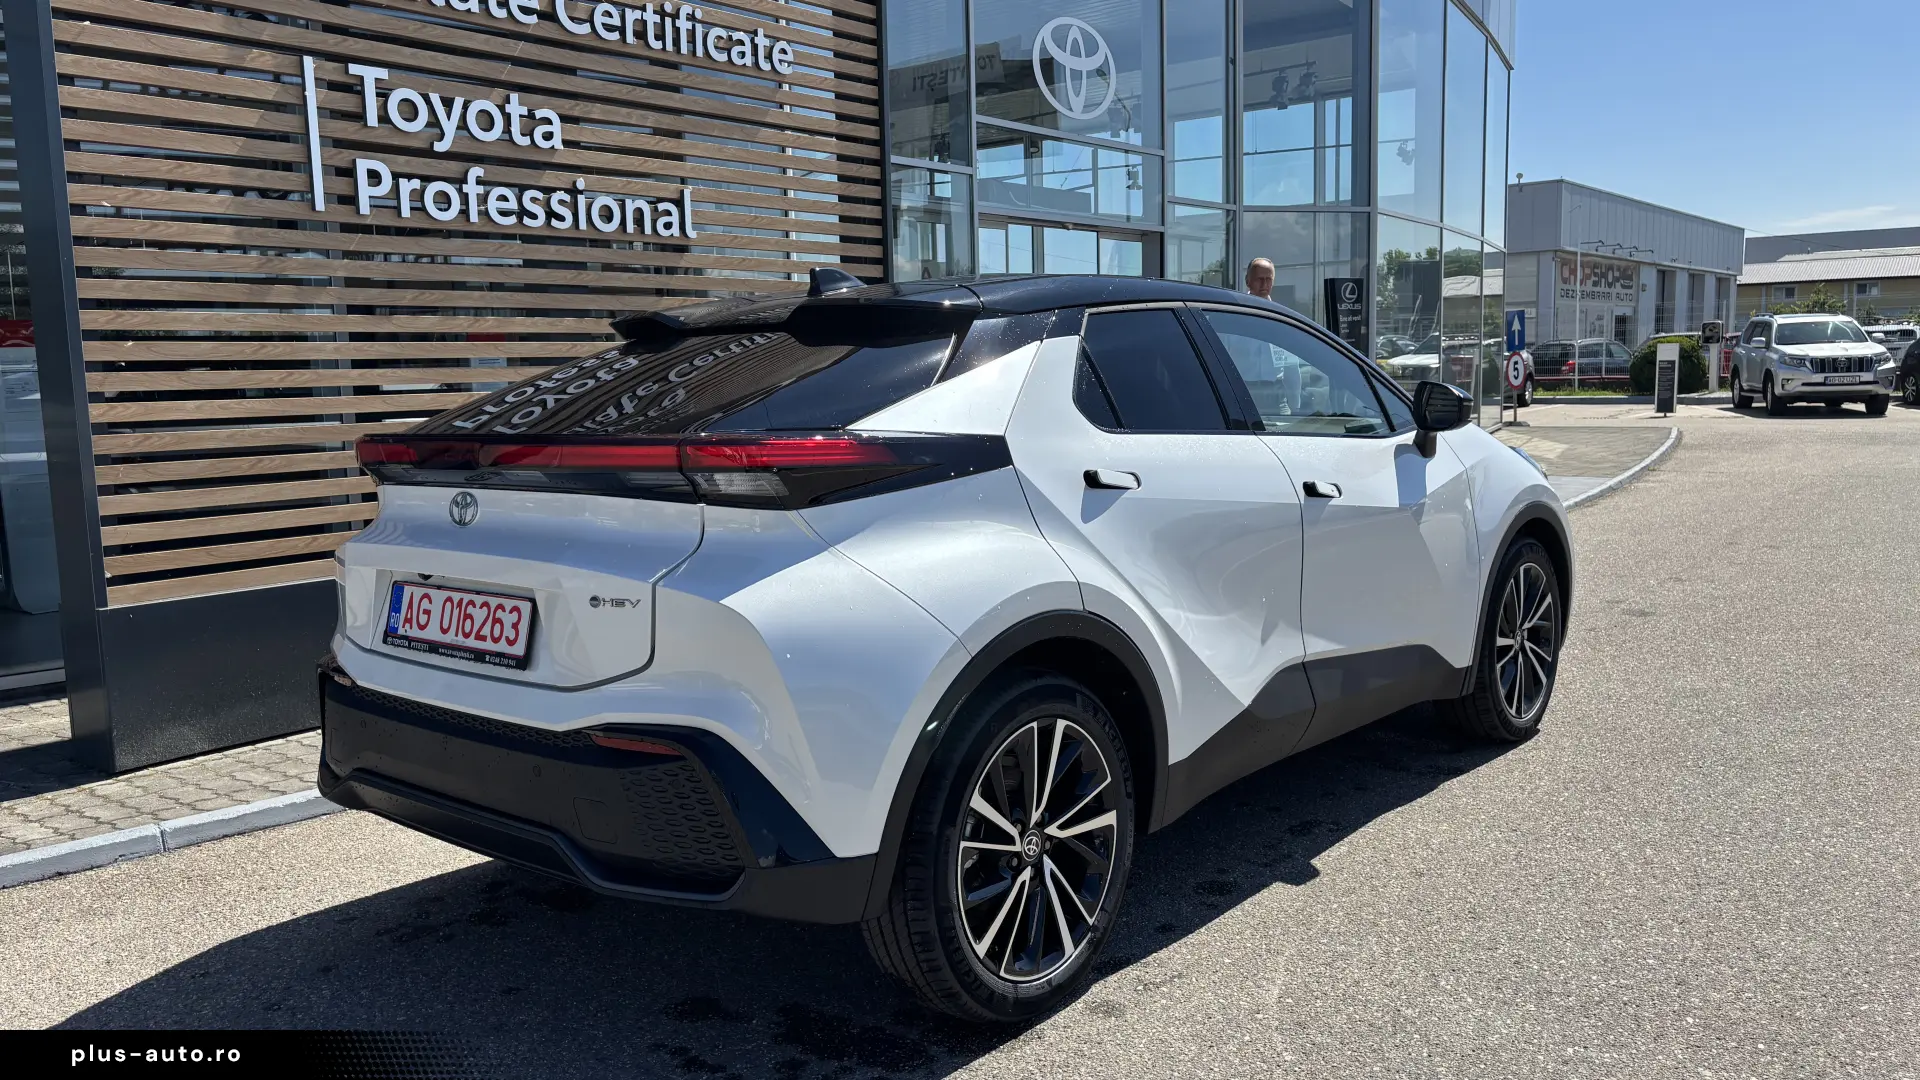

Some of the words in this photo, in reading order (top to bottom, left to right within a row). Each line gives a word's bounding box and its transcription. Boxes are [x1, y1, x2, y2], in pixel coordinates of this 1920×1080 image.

[554, 0, 794, 75] Certificate
[348, 62, 563, 153] Toyota
[354, 158, 697, 239] Professional
[1615, 292, 1633, 302] AUTO
[1513, 361, 1519, 380] 5
[389, 612, 400, 628] RO
[402, 591, 432, 631] AG
[440, 596, 522, 647] 016263
[602, 597, 641, 608] HEV
